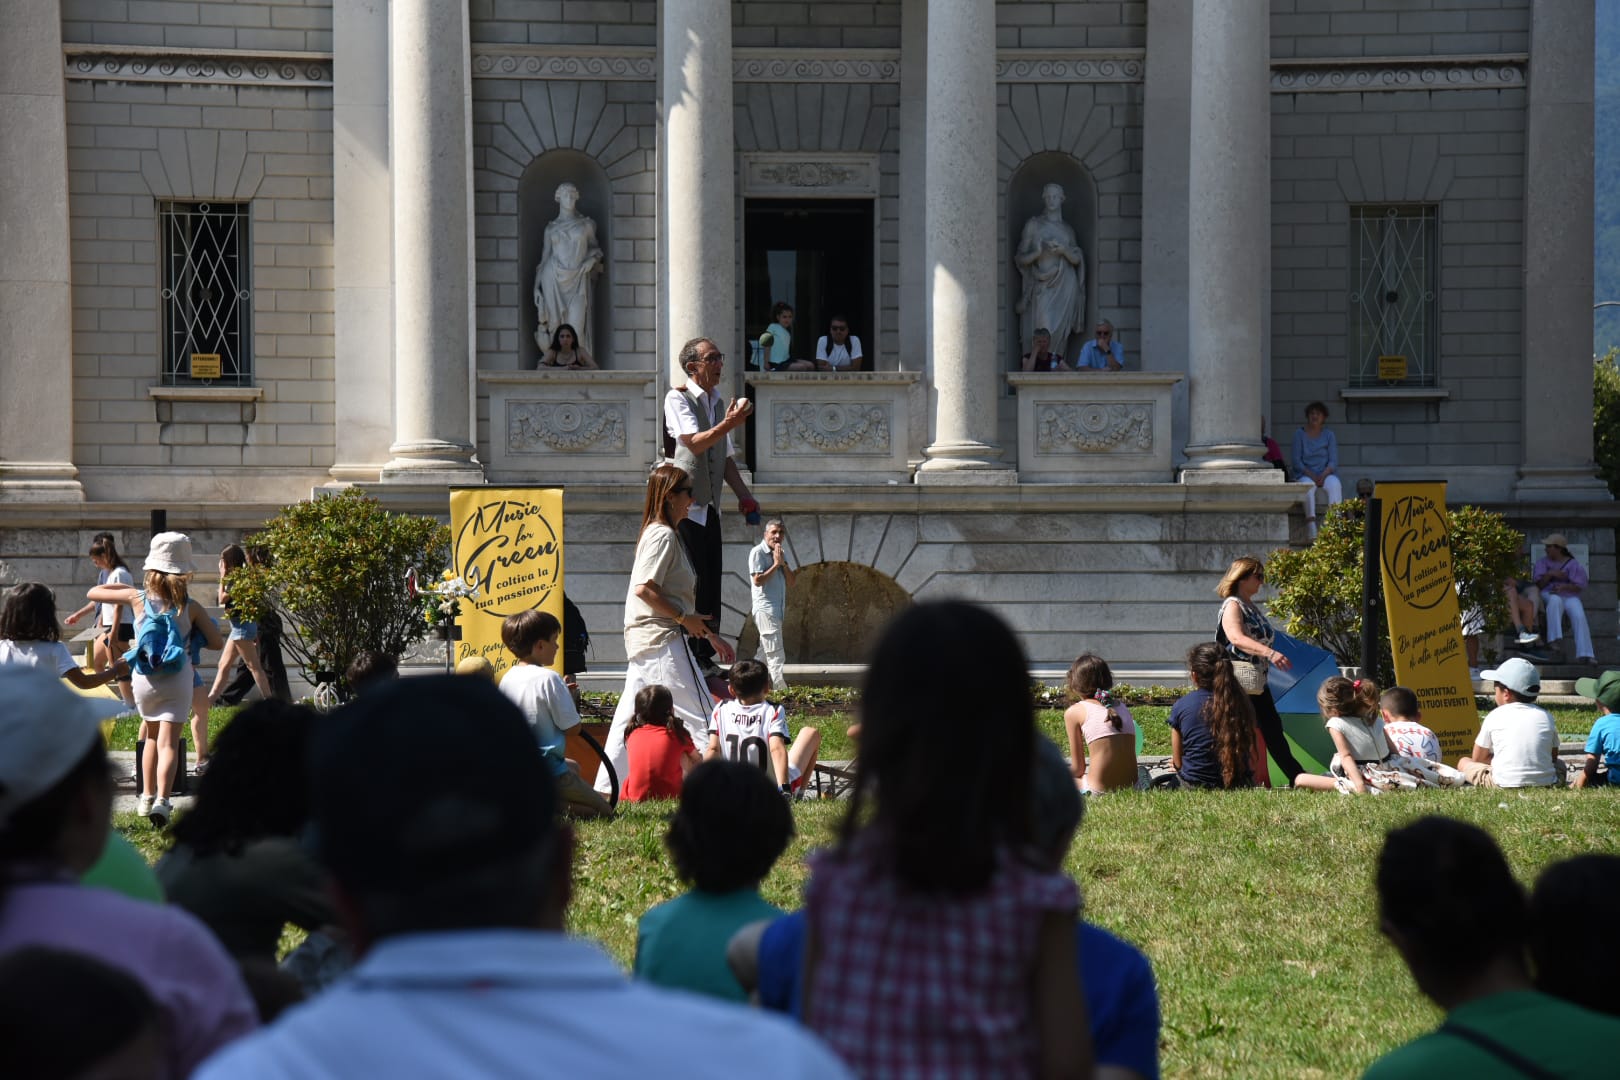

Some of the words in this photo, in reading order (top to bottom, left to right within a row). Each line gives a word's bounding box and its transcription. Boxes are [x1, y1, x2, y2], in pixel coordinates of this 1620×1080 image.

[473, 501, 542, 536] Music
[1394, 496, 1434, 531] Music
[515, 523, 535, 546] for
[1422, 518, 1433, 539] for
[463, 535, 558, 594] Green
[1393, 528, 1449, 587] Green
[496, 573, 535, 590] coltiva
[538, 567, 549, 578] la
[1414, 565, 1438, 582] coltiva
[1439, 560, 1448, 570] la
[475, 598, 494, 611] tua
[497, 582, 557, 605] passione...
[1403, 590, 1415, 602] tua
[459, 642, 478, 661] Da
[481, 642, 507, 657] semp
[1398, 635, 1410, 654] Da
[1416, 687, 1457, 697] CONTATTACI
[1426, 699, 1443, 709] TUOI
[1444, 697, 1469, 708] EVENTI
[726, 734, 768, 771] 10
